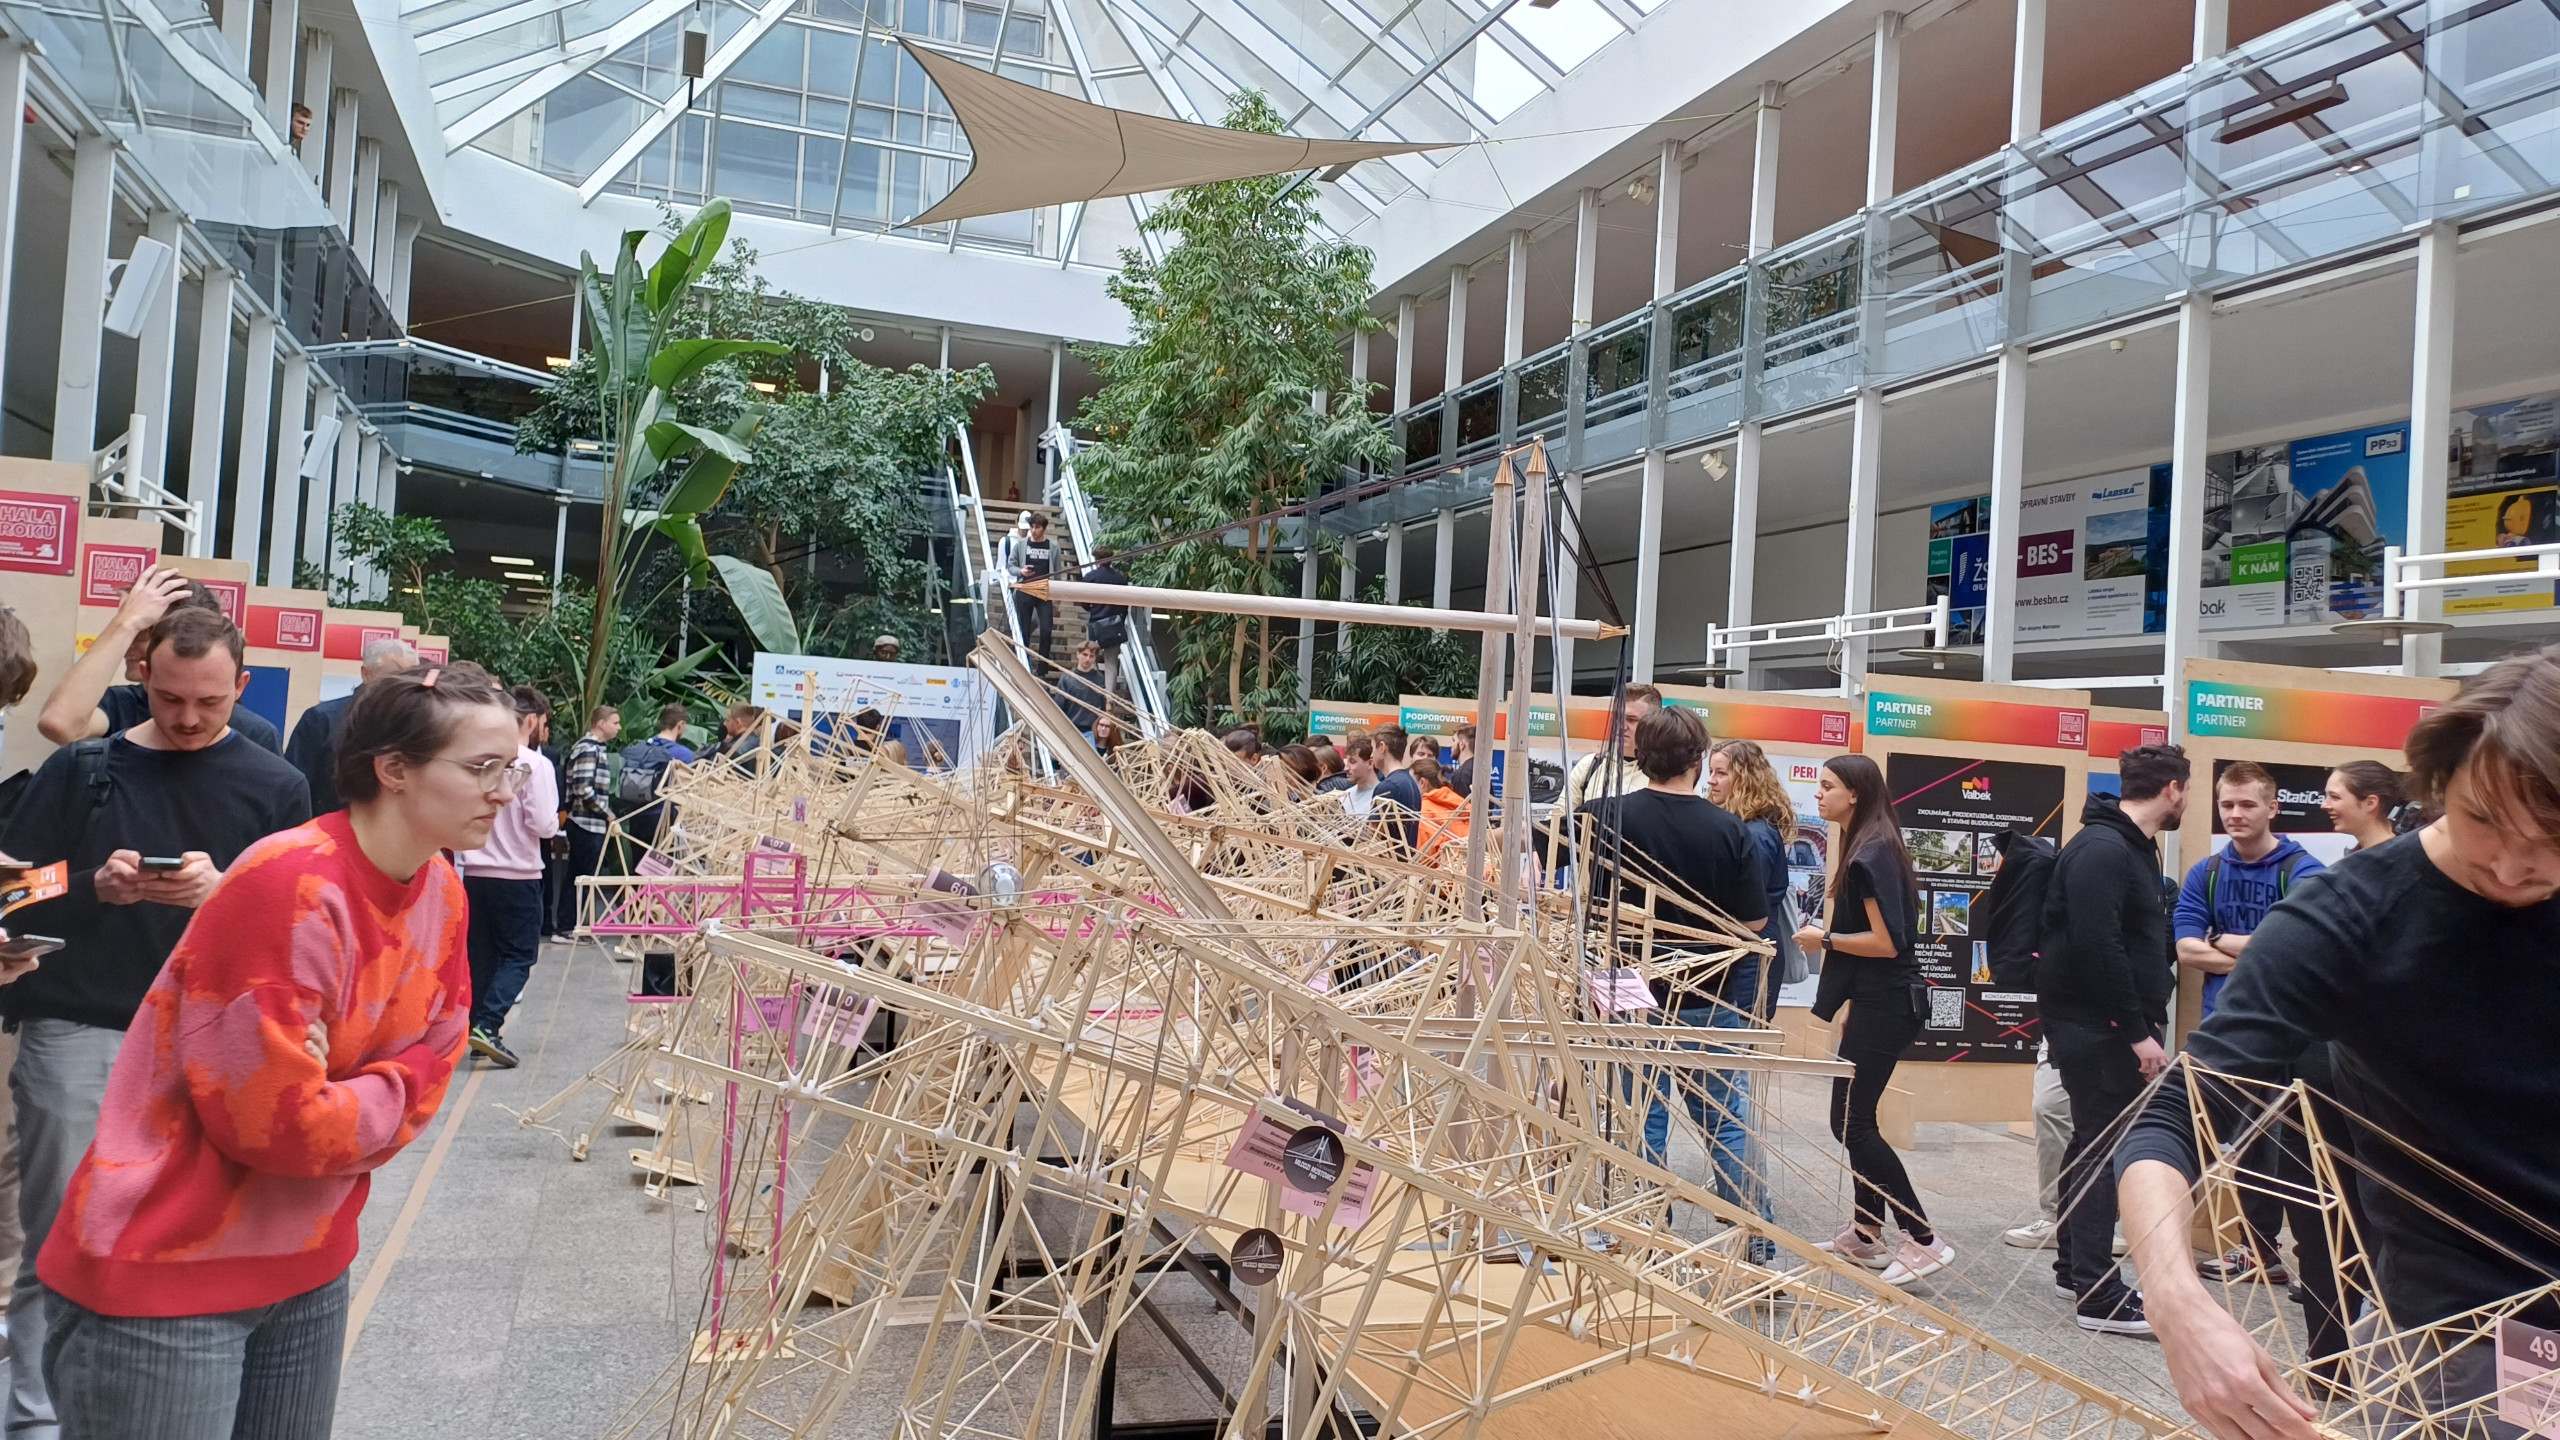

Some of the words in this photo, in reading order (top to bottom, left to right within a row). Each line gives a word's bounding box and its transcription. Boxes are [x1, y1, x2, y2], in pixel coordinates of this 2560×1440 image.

[2370, 439, 2397, 451] PP53
[2020, 495, 2048, 509] OPRAVNÍ
[2049, 492, 2076, 504] STAVBY
[1, 506, 57, 525] HALA
[0, 522, 57, 540] ROKU
[2027, 543, 2059, 567] BES
[95, 556, 138, 571] HALA
[2239, 564, 2248, 576] K
[2250, 560, 2280, 575] NÁM
[94, 568, 138, 582] ROKU
[1876, 701, 1932, 716] PARTNER
[2196, 693, 2264, 711] PARTNER
[1315, 715, 1370, 726] PODPOROVATEL
[1405, 712, 1470, 724] PODPOROVATEL
[1528, 711, 1556, 722] RTNER
[1875, 717, 1917, 729] PARTNER
[2196, 713, 2247, 728] PARTNER
[1315, 724, 1346, 732] SUPPORTER
[1405, 722, 1442, 731] SUPPORTER
[1792, 765, 1818, 779] PERI
[1962, 789, 1992, 801] Valbek
[2277, 789, 2325, 804] StatiCa
[2217, 905, 2264, 931] ARMO
[2529, 1335, 2558, 1362] 49
